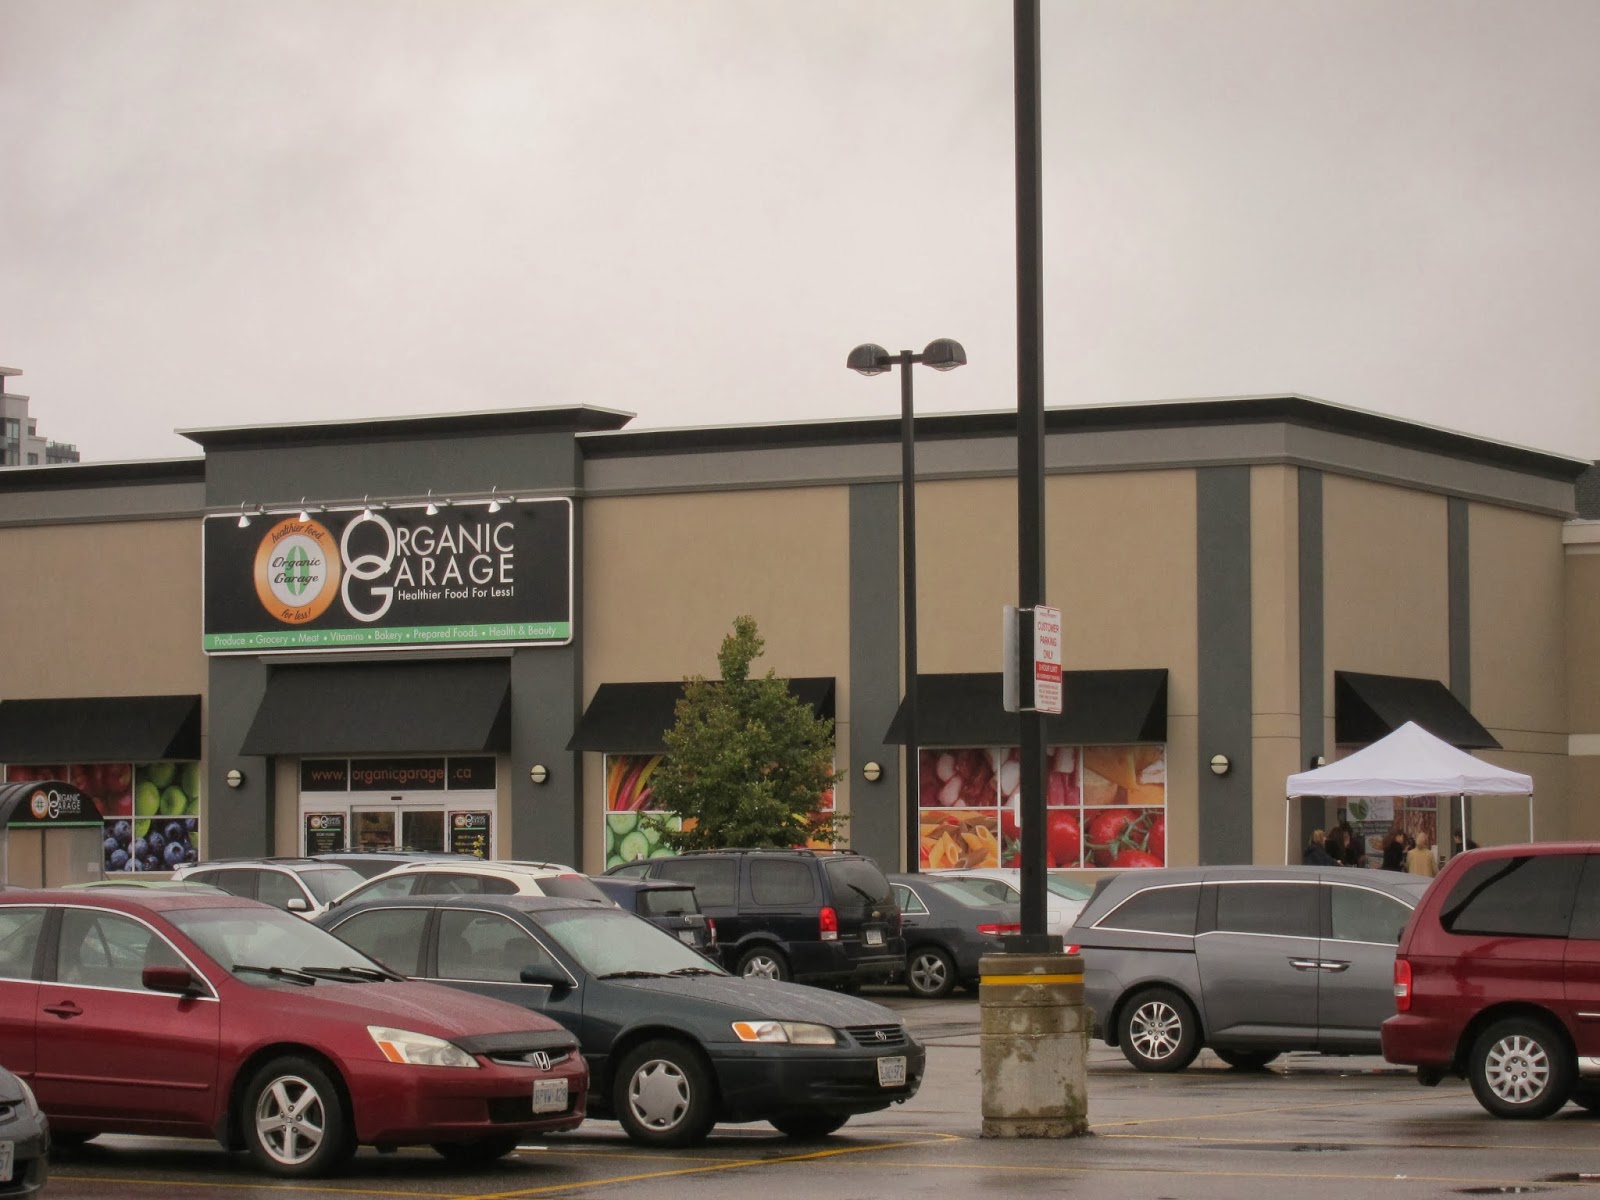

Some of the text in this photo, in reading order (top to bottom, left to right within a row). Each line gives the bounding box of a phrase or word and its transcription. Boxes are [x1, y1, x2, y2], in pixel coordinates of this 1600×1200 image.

[271, 523, 305, 544] healthier
[341, 513, 514, 580] ORGANIC
[272, 556, 321, 571] Organic
[274, 572, 319, 586] Garage
[341, 554, 514, 622] GARAGE
[398, 586, 514, 601] Healthier Food For Less!
[281, 607, 312, 621] for less!
[1038, 621, 1059, 633] CUSTOMER
[214, 624, 556, 646] Produce Grocery Meat Vitamins Bakery Prepared Foods Health & Beauty
[1040, 635, 1056, 647] PARKING
[1043, 649, 1054, 659] ONLY
